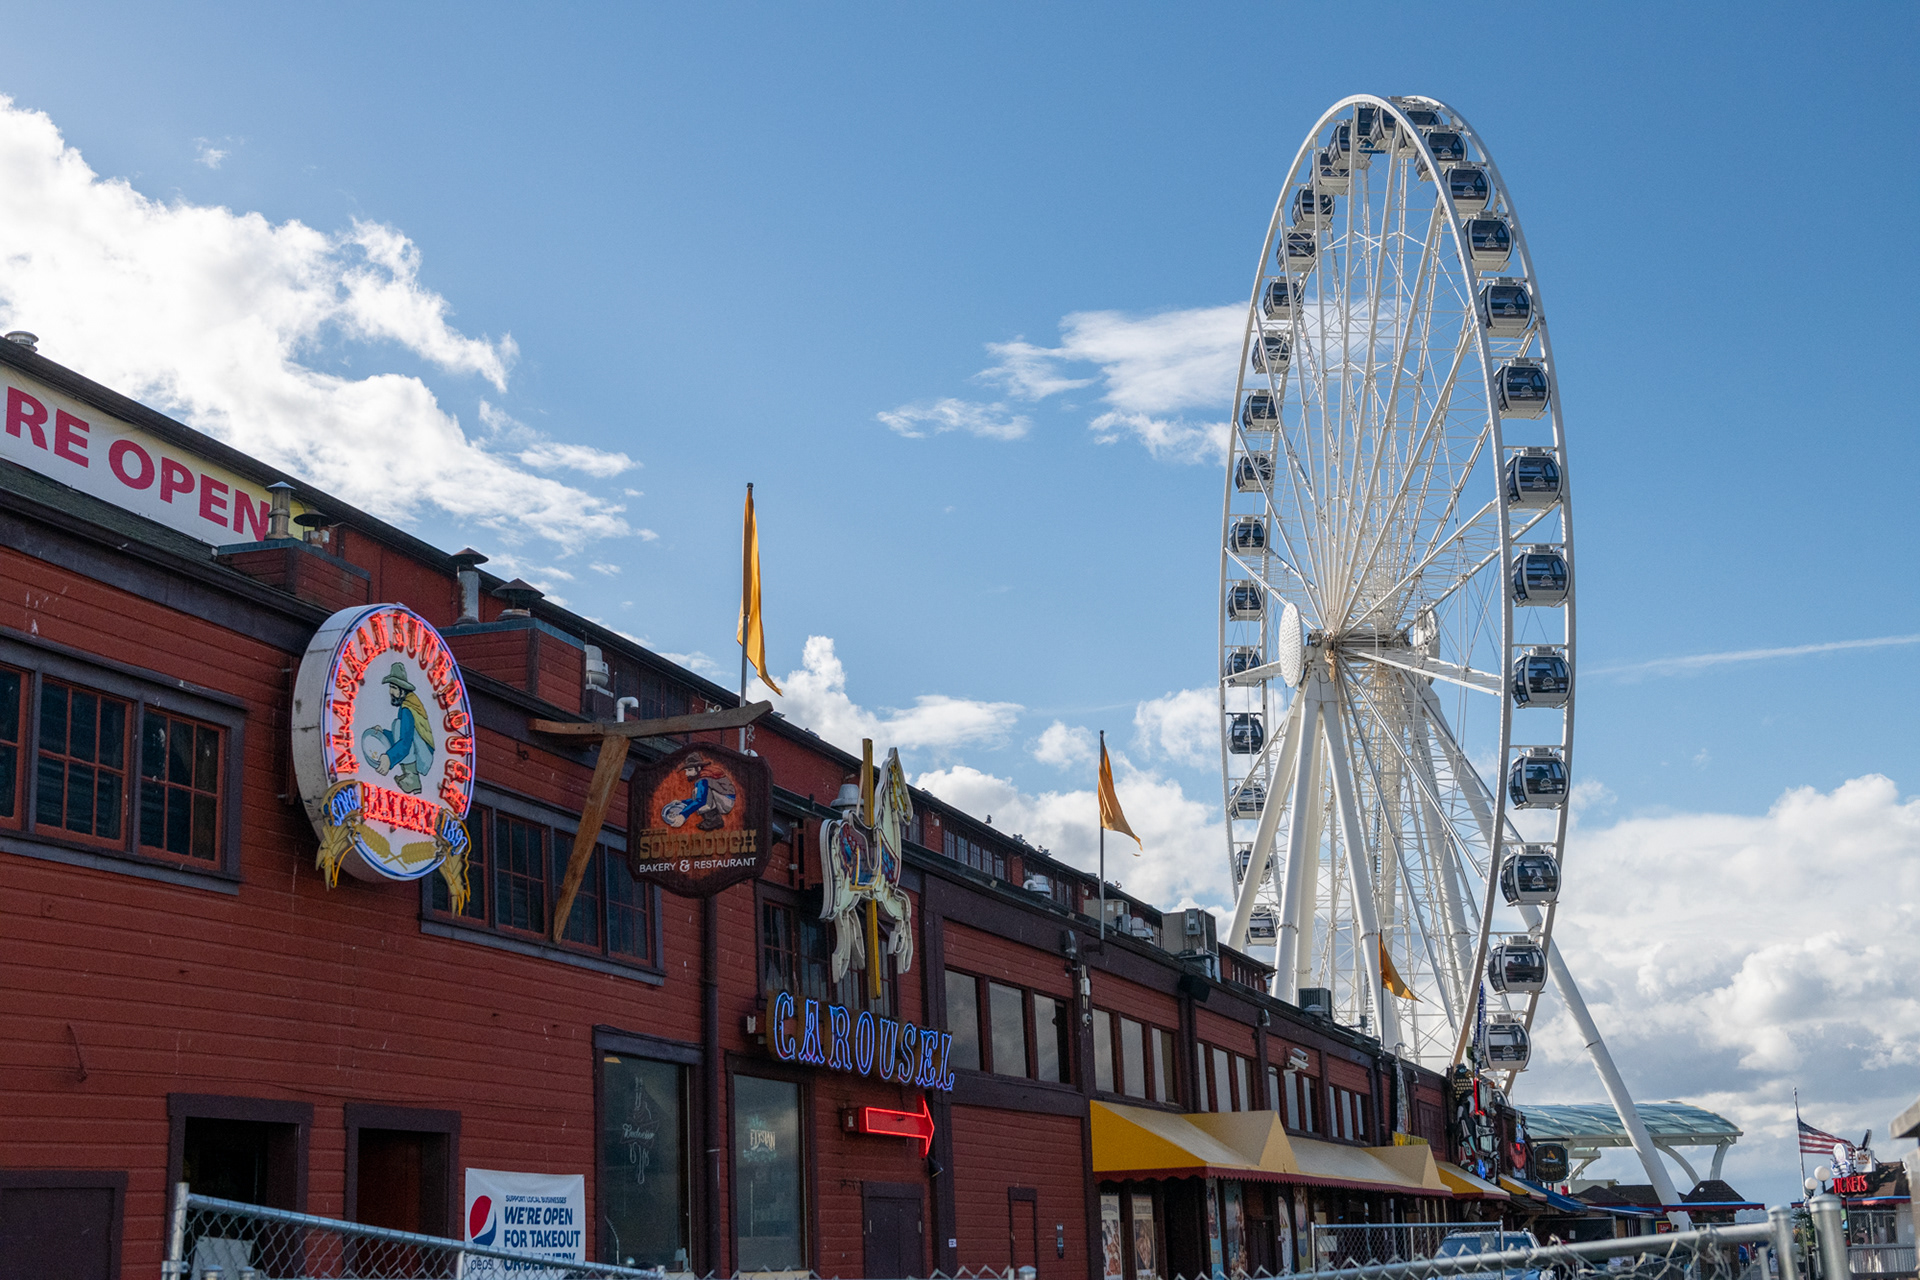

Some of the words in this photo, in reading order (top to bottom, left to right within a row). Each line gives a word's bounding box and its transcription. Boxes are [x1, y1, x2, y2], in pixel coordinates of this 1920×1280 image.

[5, 386, 90, 468] RE
[108, 439, 271, 542] OPEN
[326, 612, 391, 774] ALASKAN
[392, 611, 473, 815] SOURDOUGH
[363, 781, 442, 836] BAKERY
[640, 829, 757, 860] SOURDOUGH
[640, 862, 676, 873] BAKERY
[680, 860, 690, 872] &
[694, 857, 756, 869] RESTAURANT
[773, 991, 956, 1091] CAROUSEL
[1832, 1175, 1868, 1194] TICKETS
[527, 1195, 541, 1203] LOCAL
[541, 1196, 567, 1204] BUSINESSES
[504, 1206, 541, 1225] WE'RE
[543, 1207, 573, 1225] OPEN
[504, 1229, 527, 1248] FOR
[529, 1230, 580, 1248] TAKEOUT
